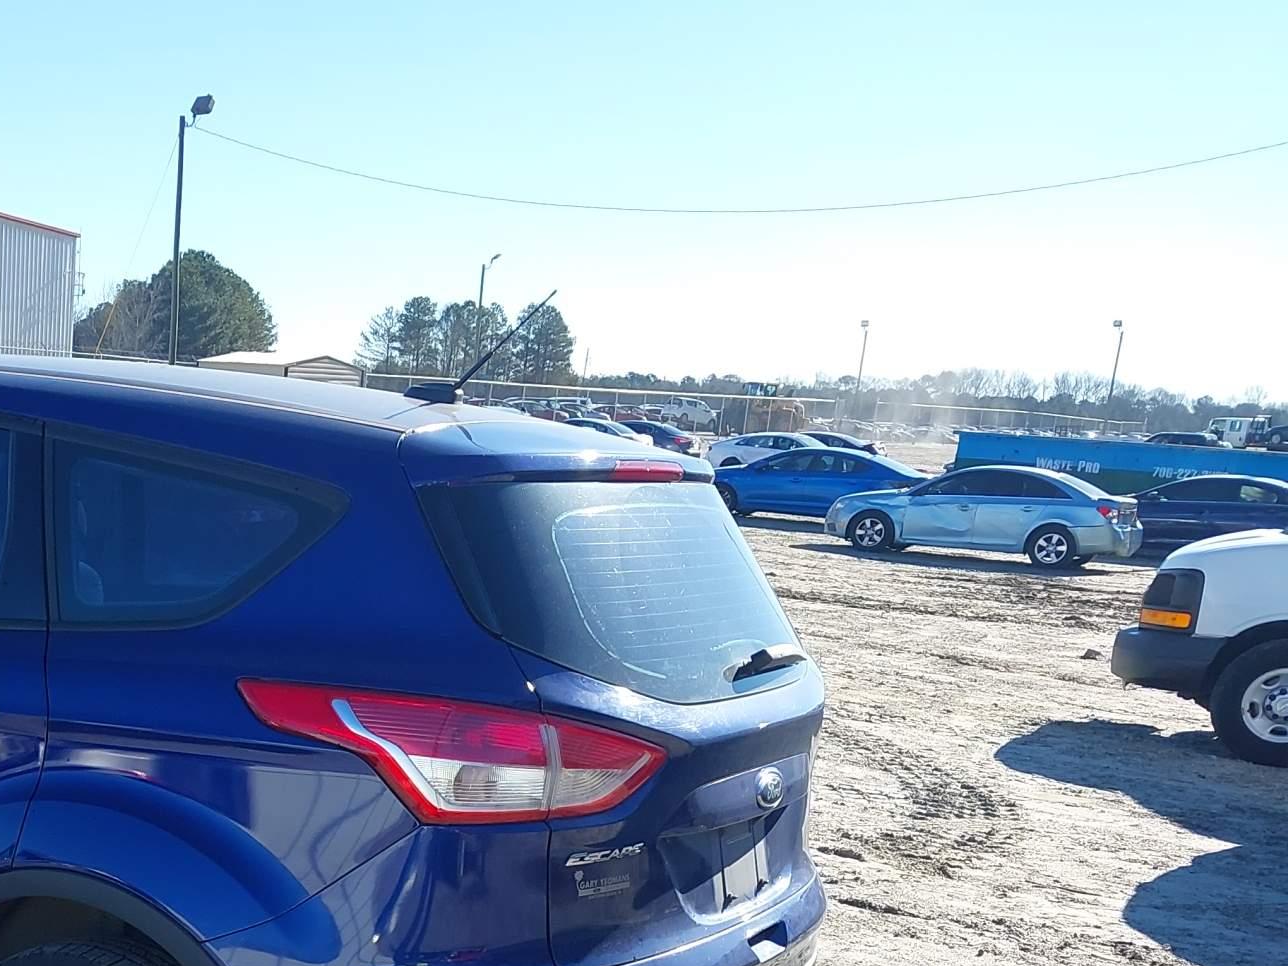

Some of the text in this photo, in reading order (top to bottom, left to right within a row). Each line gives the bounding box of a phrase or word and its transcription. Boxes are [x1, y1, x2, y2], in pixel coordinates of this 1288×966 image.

[1036, 457, 1101, 474] WASTE PRO
[565, 842, 645, 867] ESCAPE
[579, 880, 599, 890] GARY
